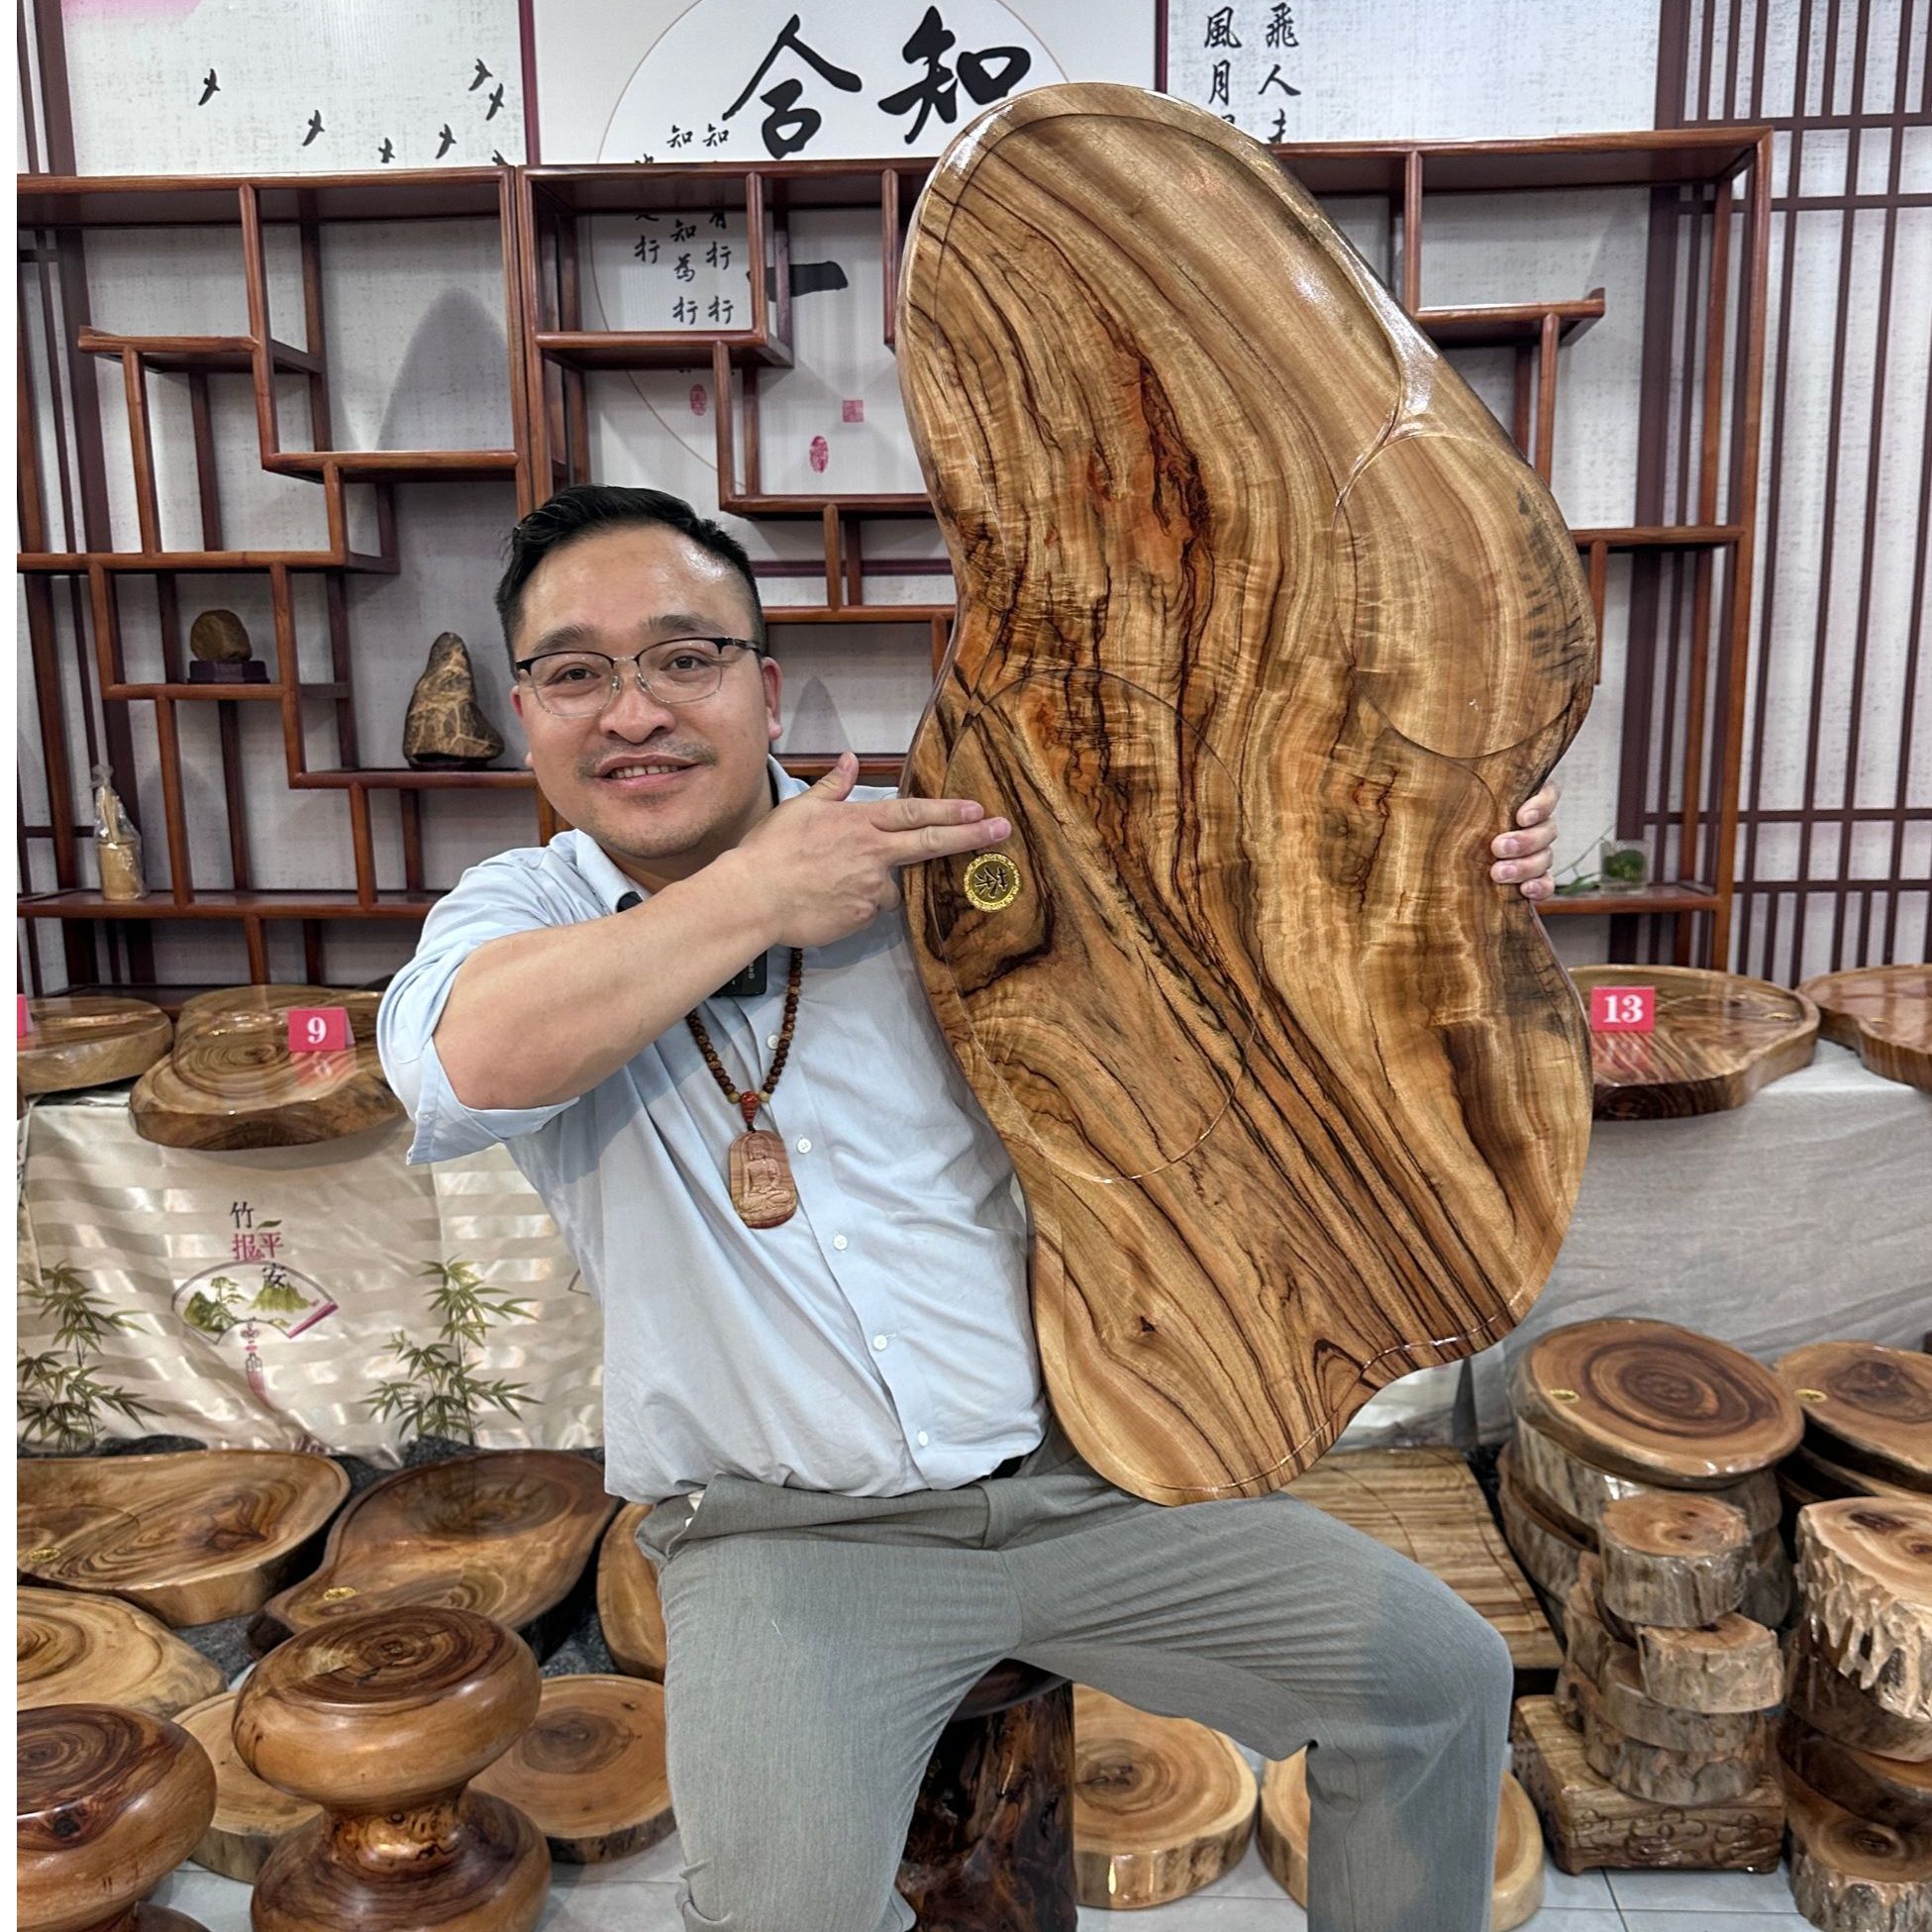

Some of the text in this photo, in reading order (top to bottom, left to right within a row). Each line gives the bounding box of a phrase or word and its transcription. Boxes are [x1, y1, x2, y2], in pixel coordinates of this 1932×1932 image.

[1204, 6, 1243, 125] 風月
[1602, 994, 1644, 1024] 13
[307, 1016, 327, 1045] 9
